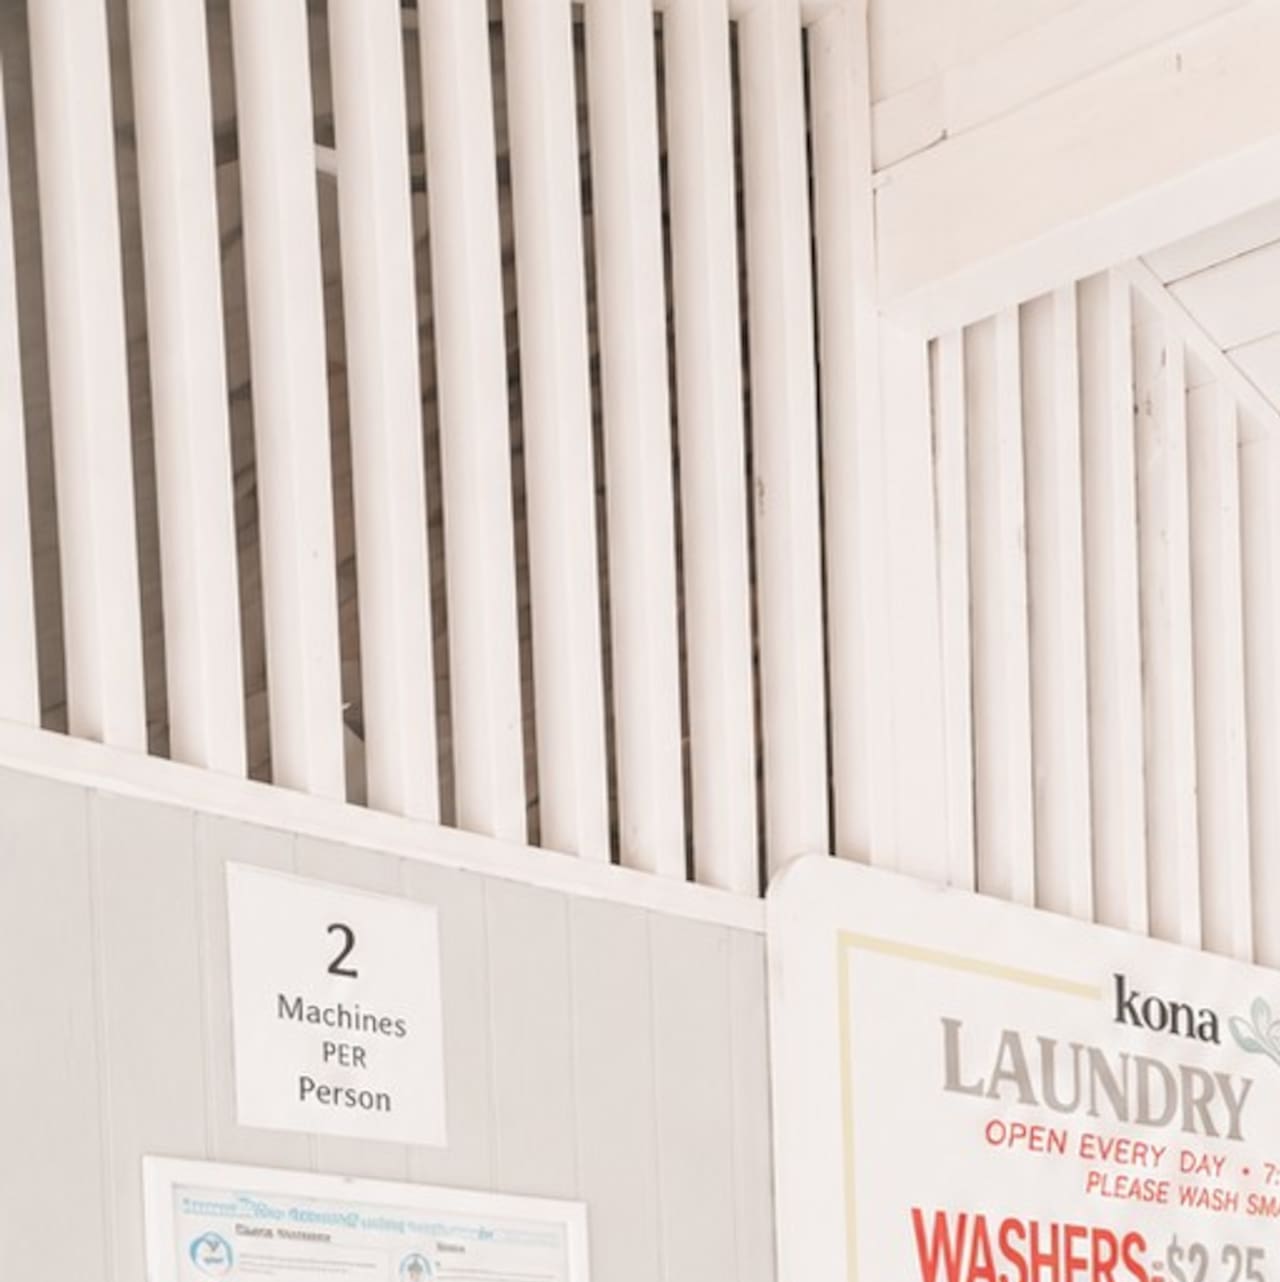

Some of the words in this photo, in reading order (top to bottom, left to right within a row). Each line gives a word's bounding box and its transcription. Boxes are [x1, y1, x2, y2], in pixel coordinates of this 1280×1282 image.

[326, 922, 358, 979] 2
[277, 994, 407, 1038] Machines
[1114, 973, 1221, 1045] kona
[322, 1041, 368, 1068] PER
[940, 1017, 1253, 1142] LAUNDRY
[299, 1076, 391, 1112] Person
[985, 1119, 1067, 1155] OPEN
[1079, 1133, 1166, 1168] EVERY
[1180, 1150, 1226, 1178] DAY
[1086, 1170, 1170, 1205] PLEASE
[1179, 1184, 1239, 1214] WASH
